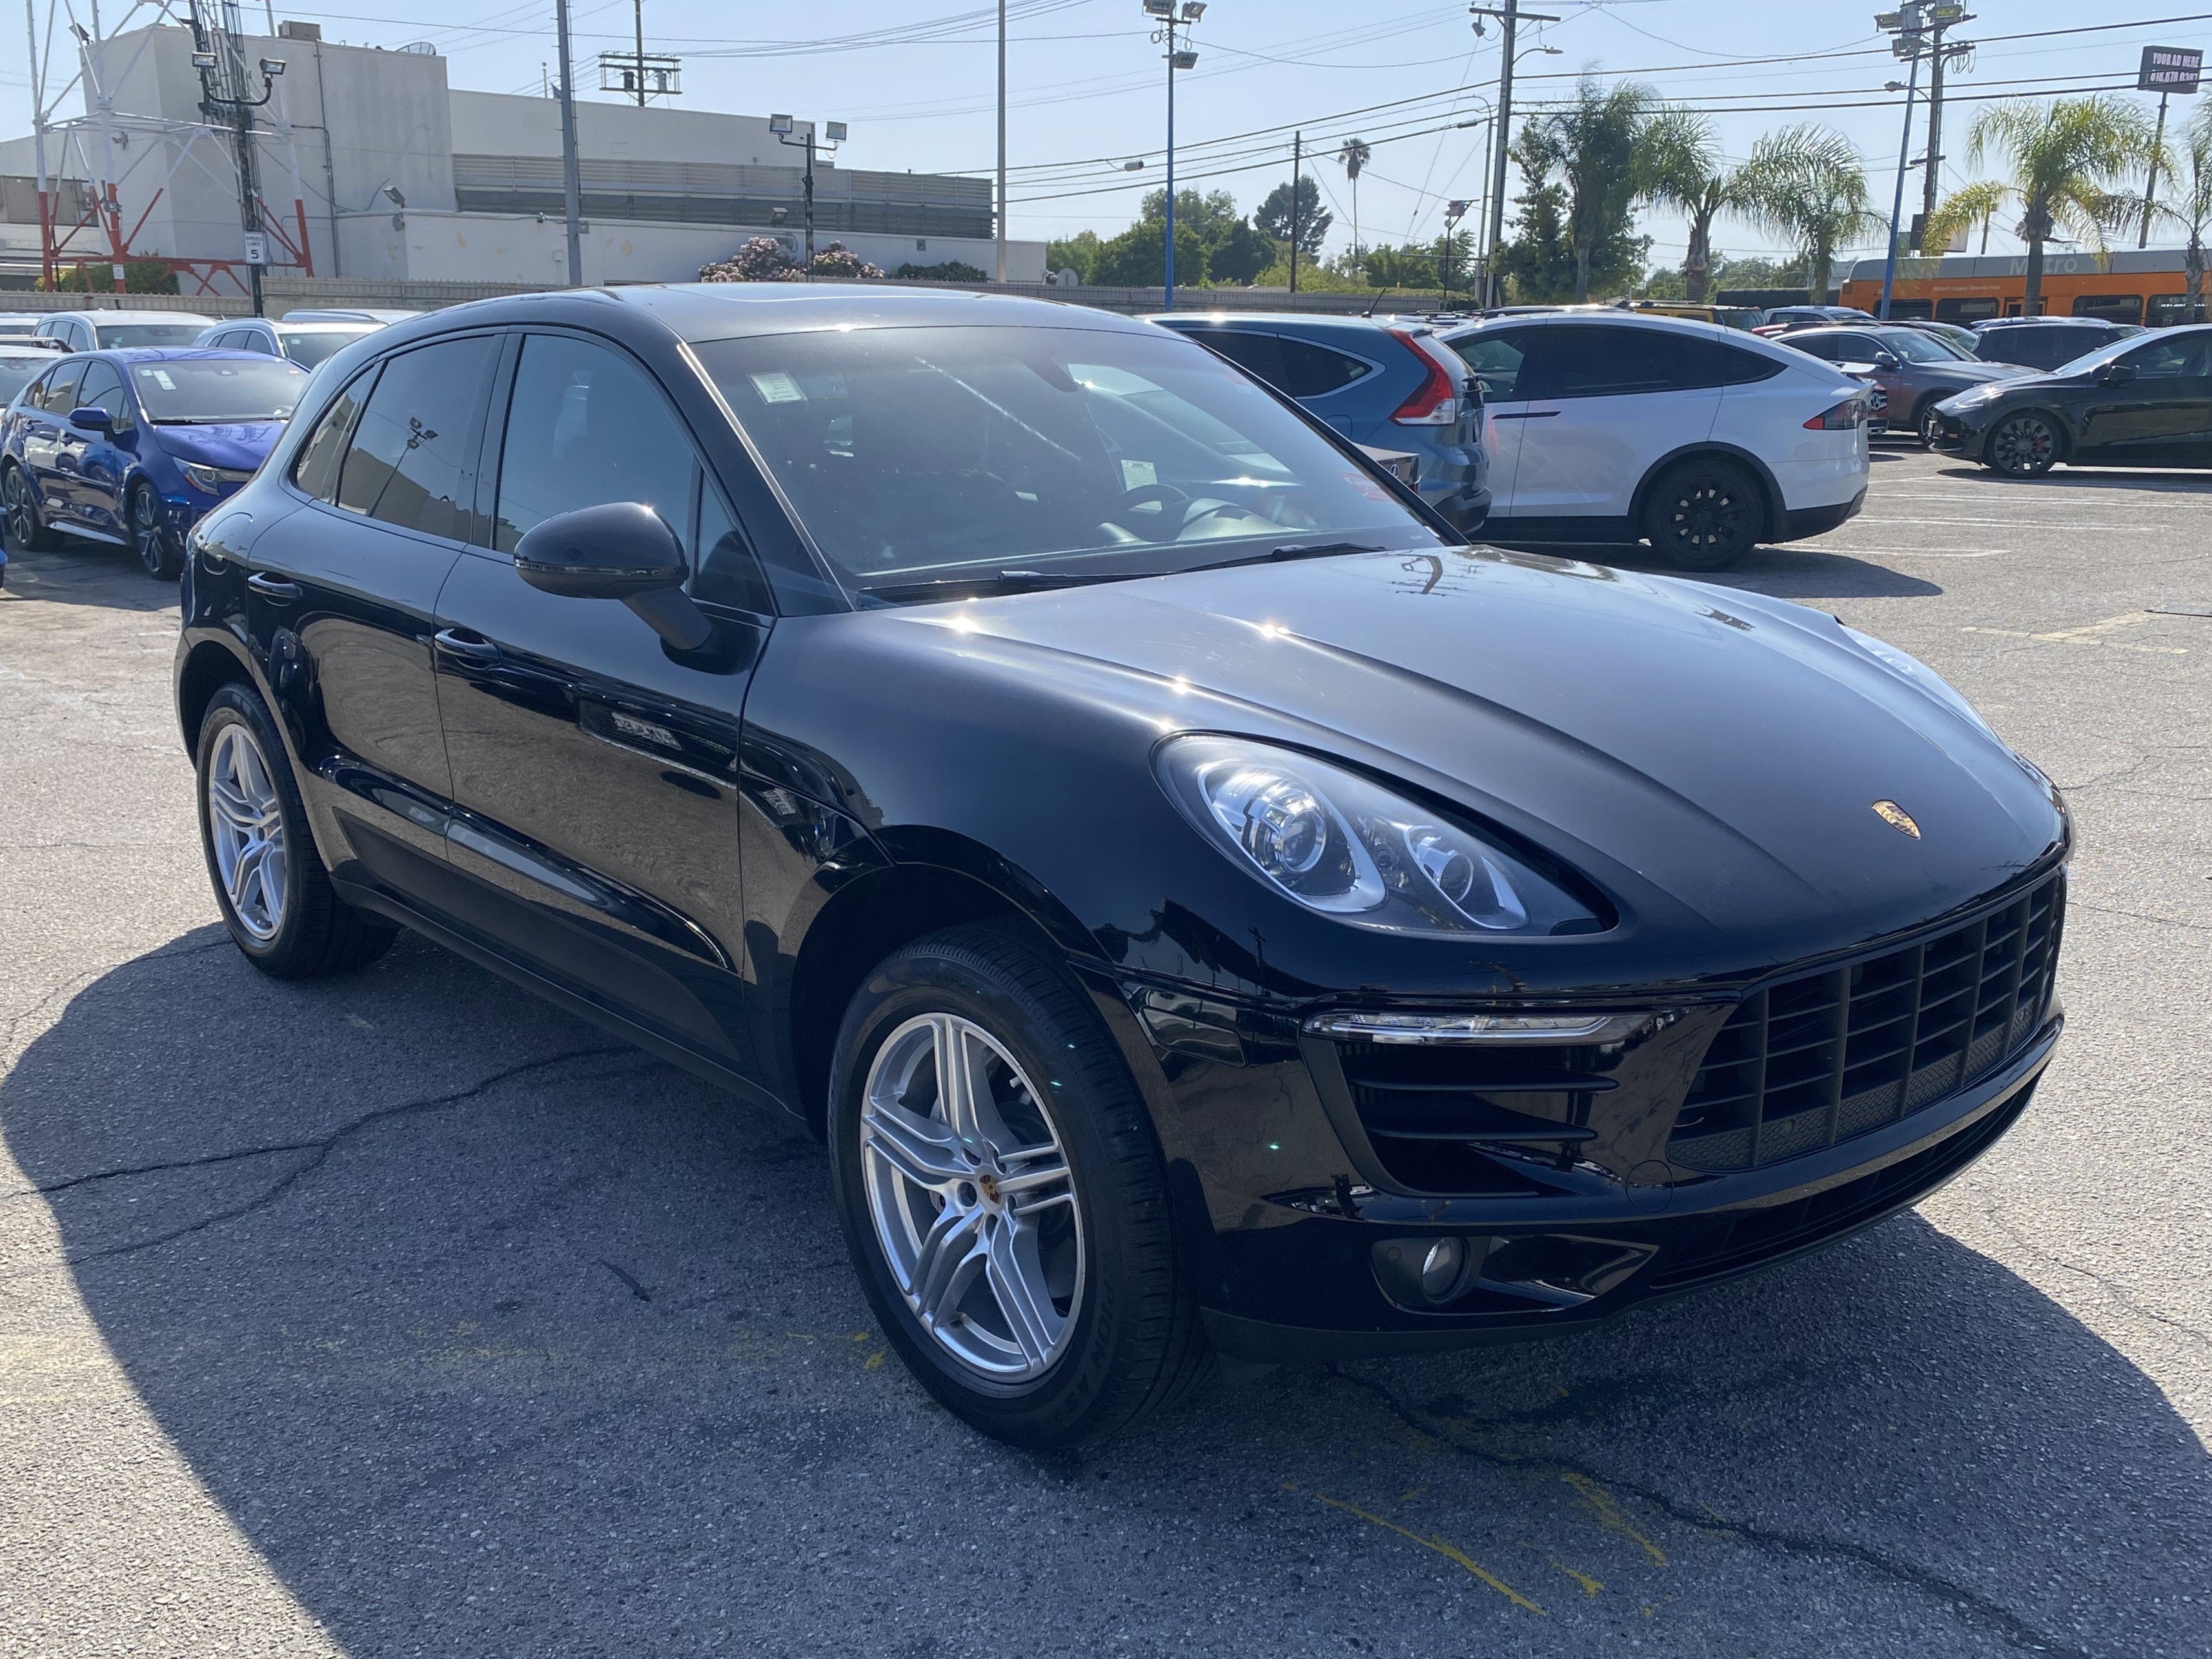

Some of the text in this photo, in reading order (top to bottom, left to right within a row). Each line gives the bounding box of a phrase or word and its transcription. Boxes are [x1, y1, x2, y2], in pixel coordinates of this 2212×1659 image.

[2153, 52, 2200, 68] YOUR AD HERE
[251, 249, 259, 259] 5
[2009, 257, 2078, 275] Mtro
